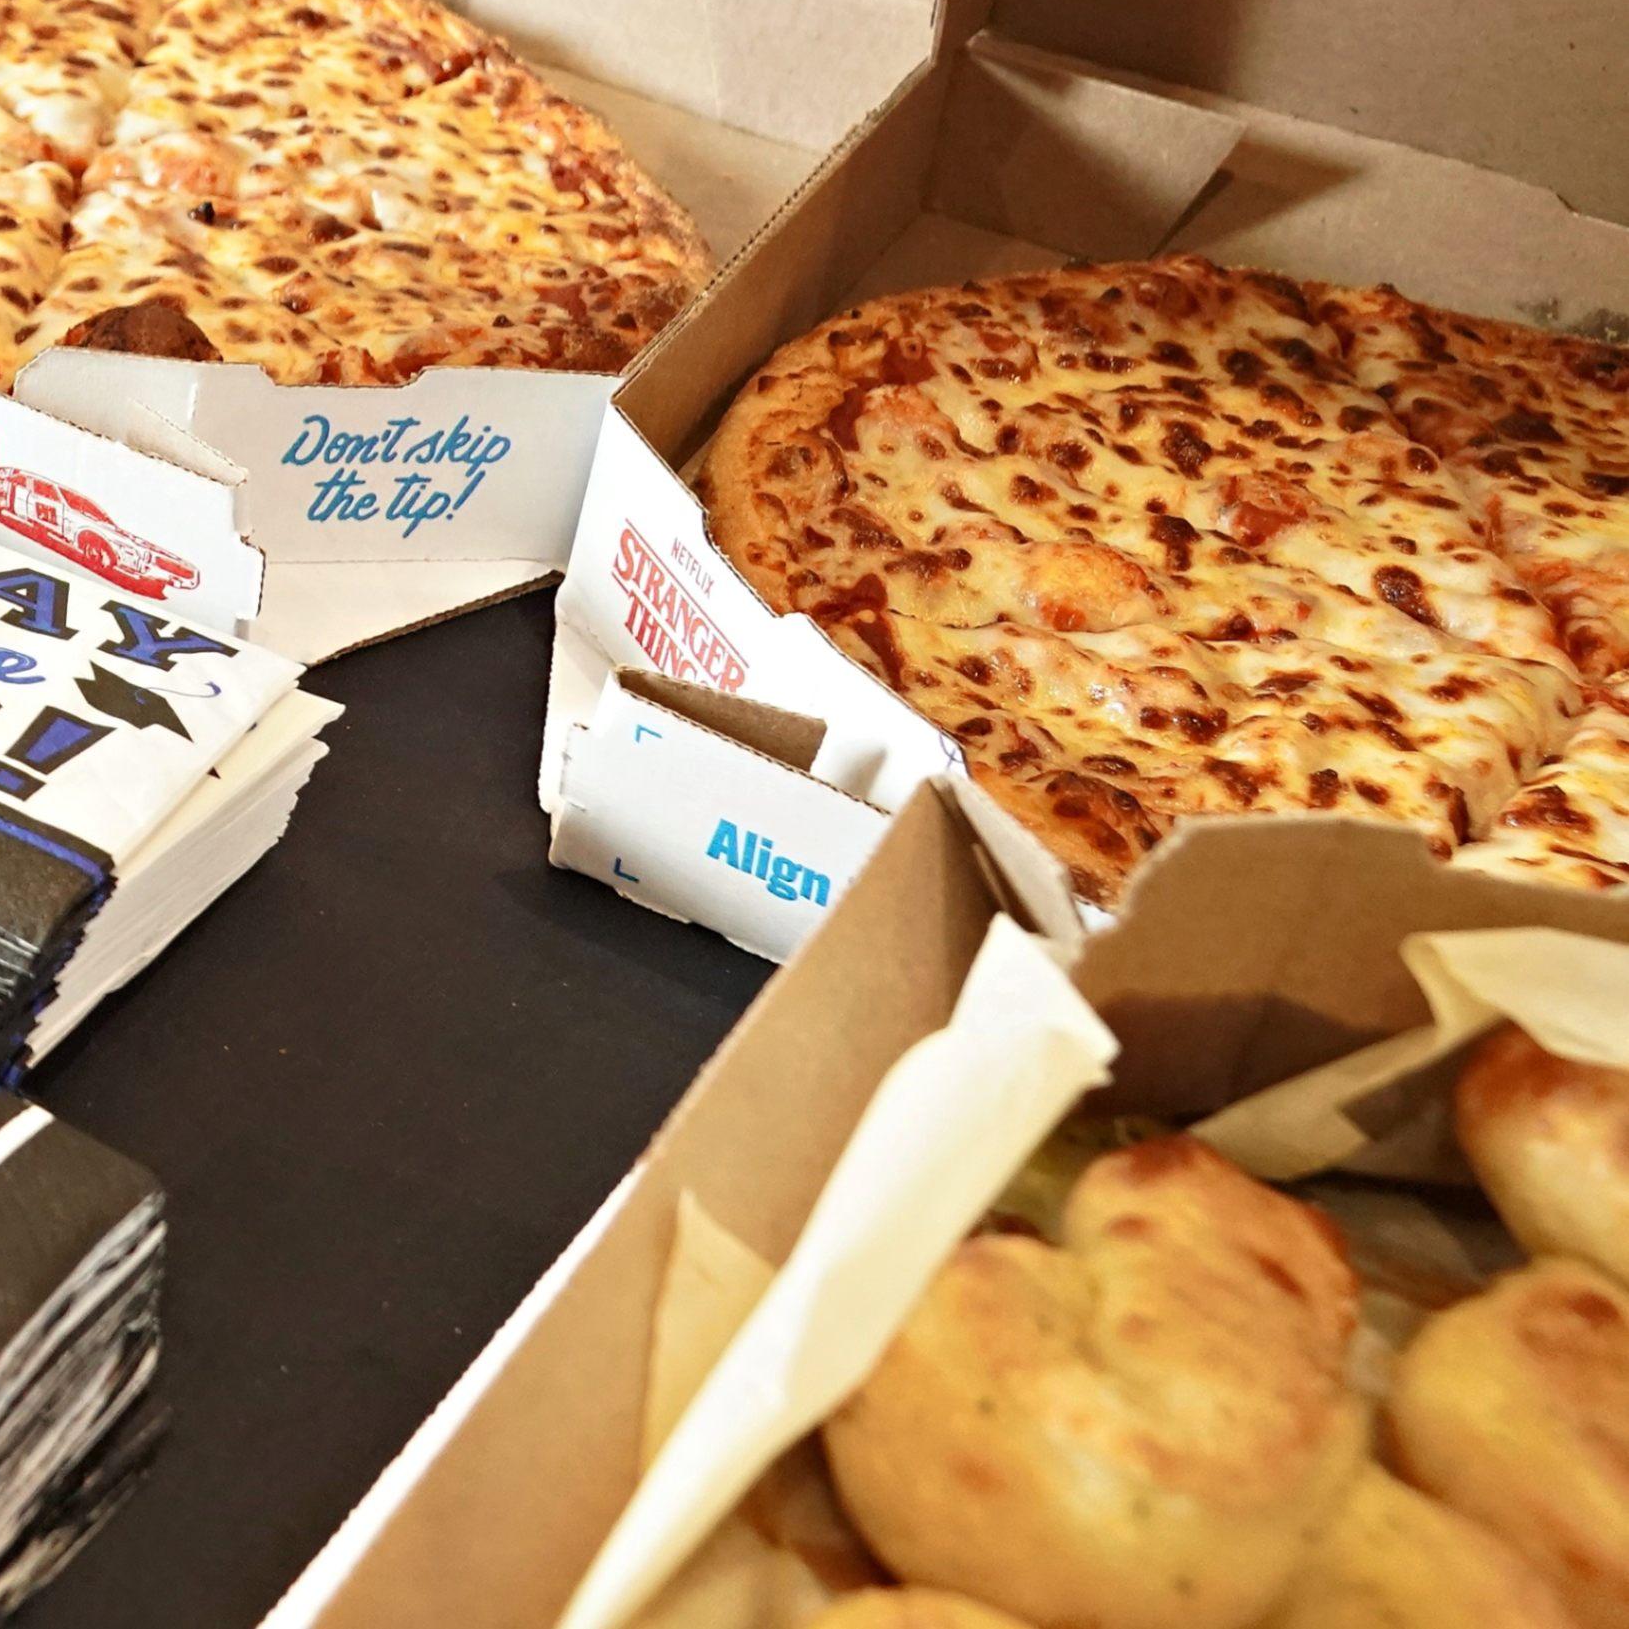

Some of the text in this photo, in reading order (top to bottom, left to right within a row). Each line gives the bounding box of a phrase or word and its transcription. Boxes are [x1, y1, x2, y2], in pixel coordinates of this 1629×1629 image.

[281, 414, 512, 478] Don't skip
[307, 467, 487, 539] the tip!
[671, 537, 714, 599] NETFLIX
[613, 527, 746, 693] STRANGER
[706, 818, 831, 907] Align
